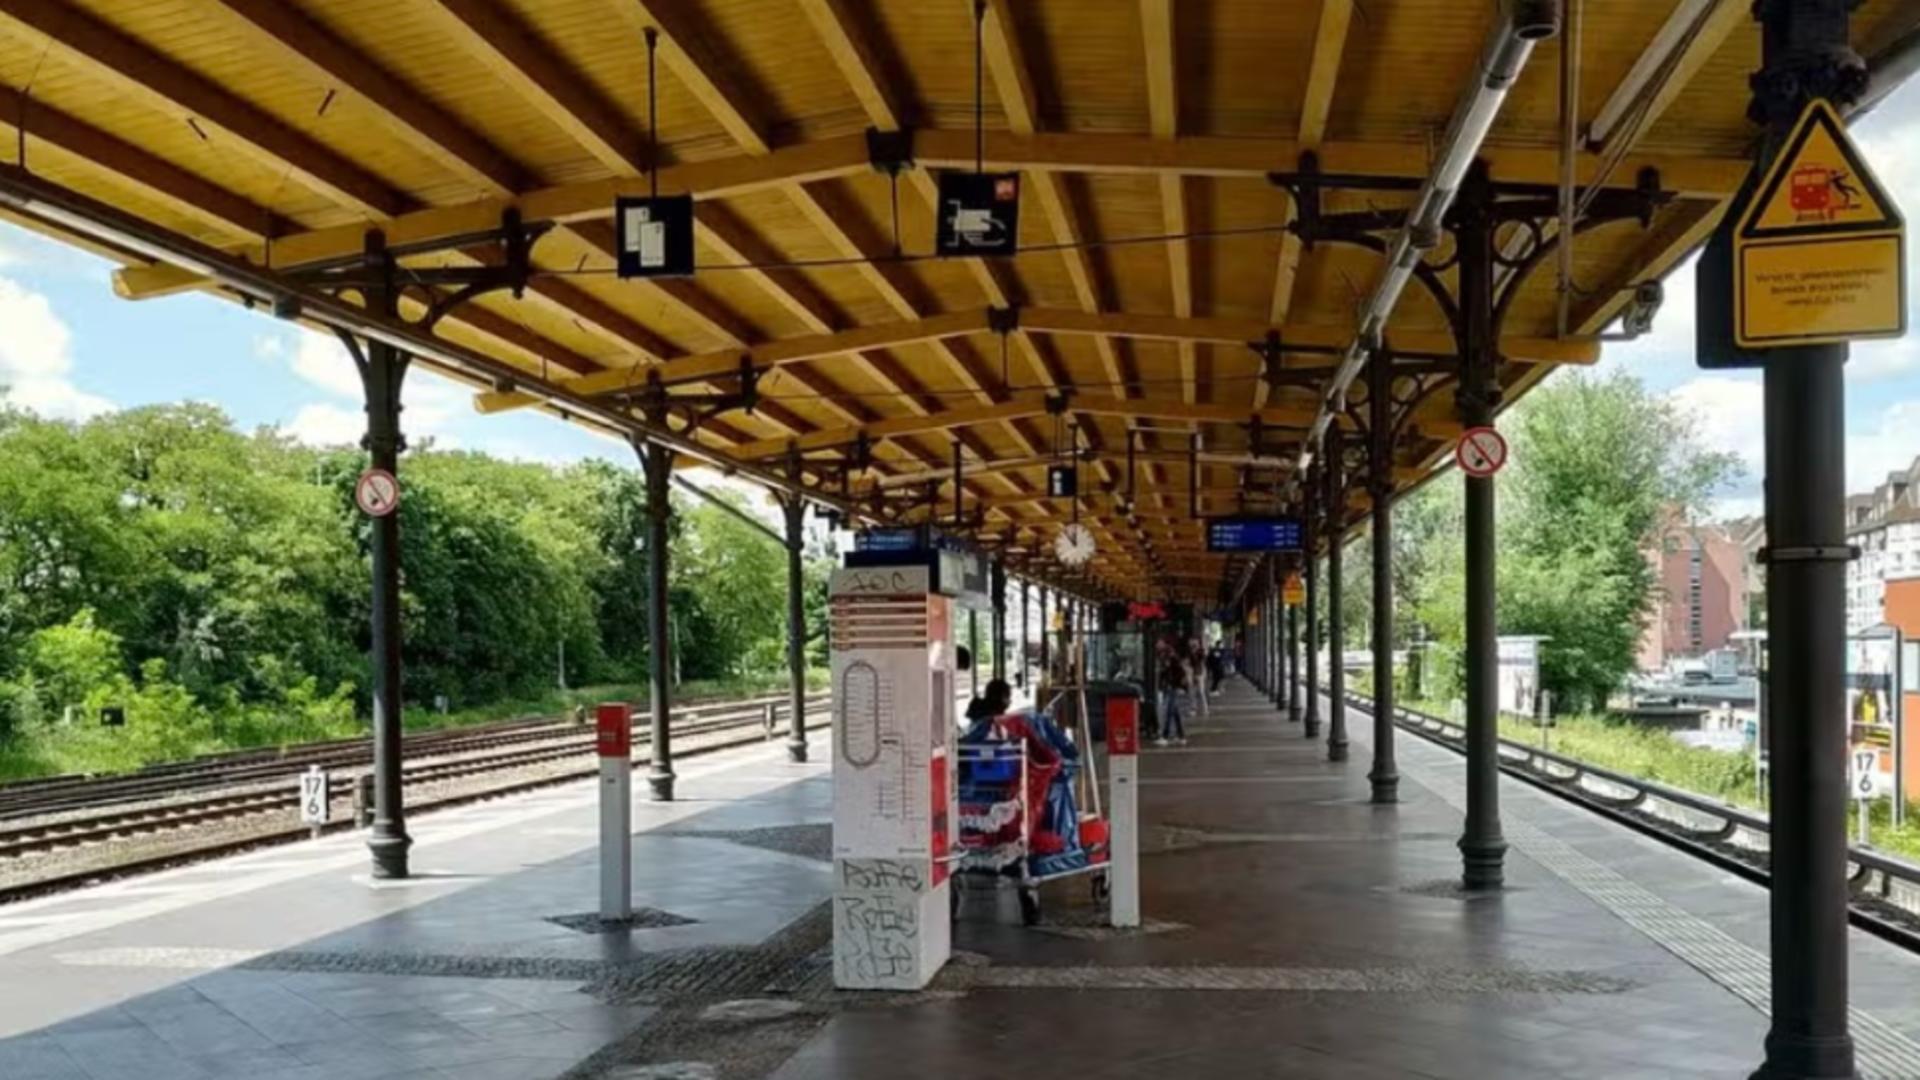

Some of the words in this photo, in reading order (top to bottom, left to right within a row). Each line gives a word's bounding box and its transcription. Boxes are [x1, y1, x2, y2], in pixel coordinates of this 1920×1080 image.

[1855, 752, 1875, 771] 17
[305, 777, 321, 794] 17
[1859, 774, 1872, 792] 6
[307, 797, 320, 815] 6
